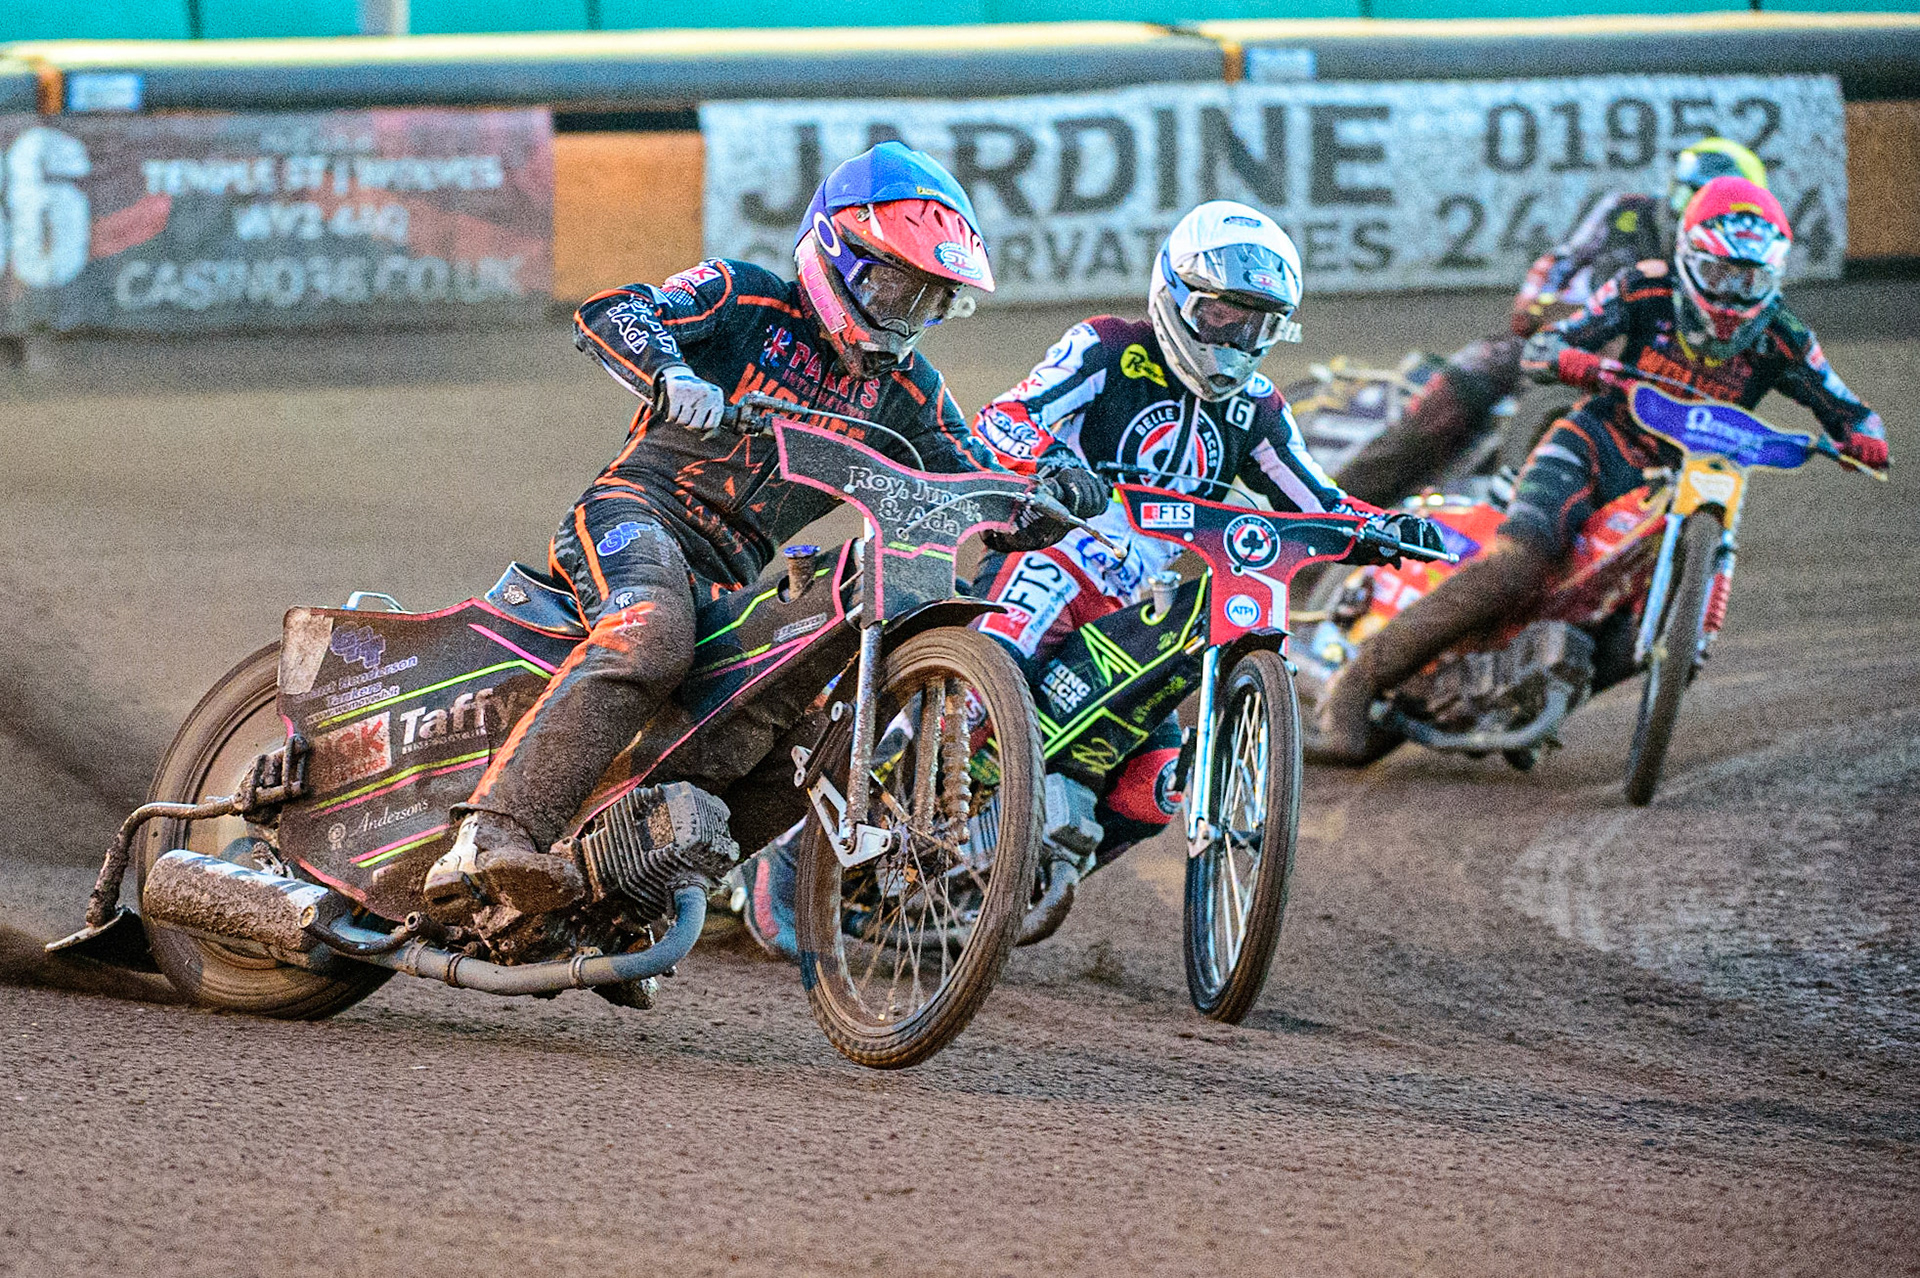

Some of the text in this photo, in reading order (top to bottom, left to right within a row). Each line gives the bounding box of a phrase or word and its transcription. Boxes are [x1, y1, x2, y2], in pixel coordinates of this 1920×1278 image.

[1484, 94, 1785, 173] 01952
[741, 104, 1394, 226] JRDINE
[0, 126, 92, 288] 6
[1233, 400, 1250, 425] 6
[1135, 408, 1174, 437] BELLE
[1202, 431, 1218, 468] ACES
[878, 498, 902, 522] &
[1159, 503, 1191, 520] FTS
[1003, 556, 1063, 616] FTS
[1231, 605, 1254, 617] ATPI
[338, 655, 418, 690] Henderson
[357, 799, 430, 836] Andersons
